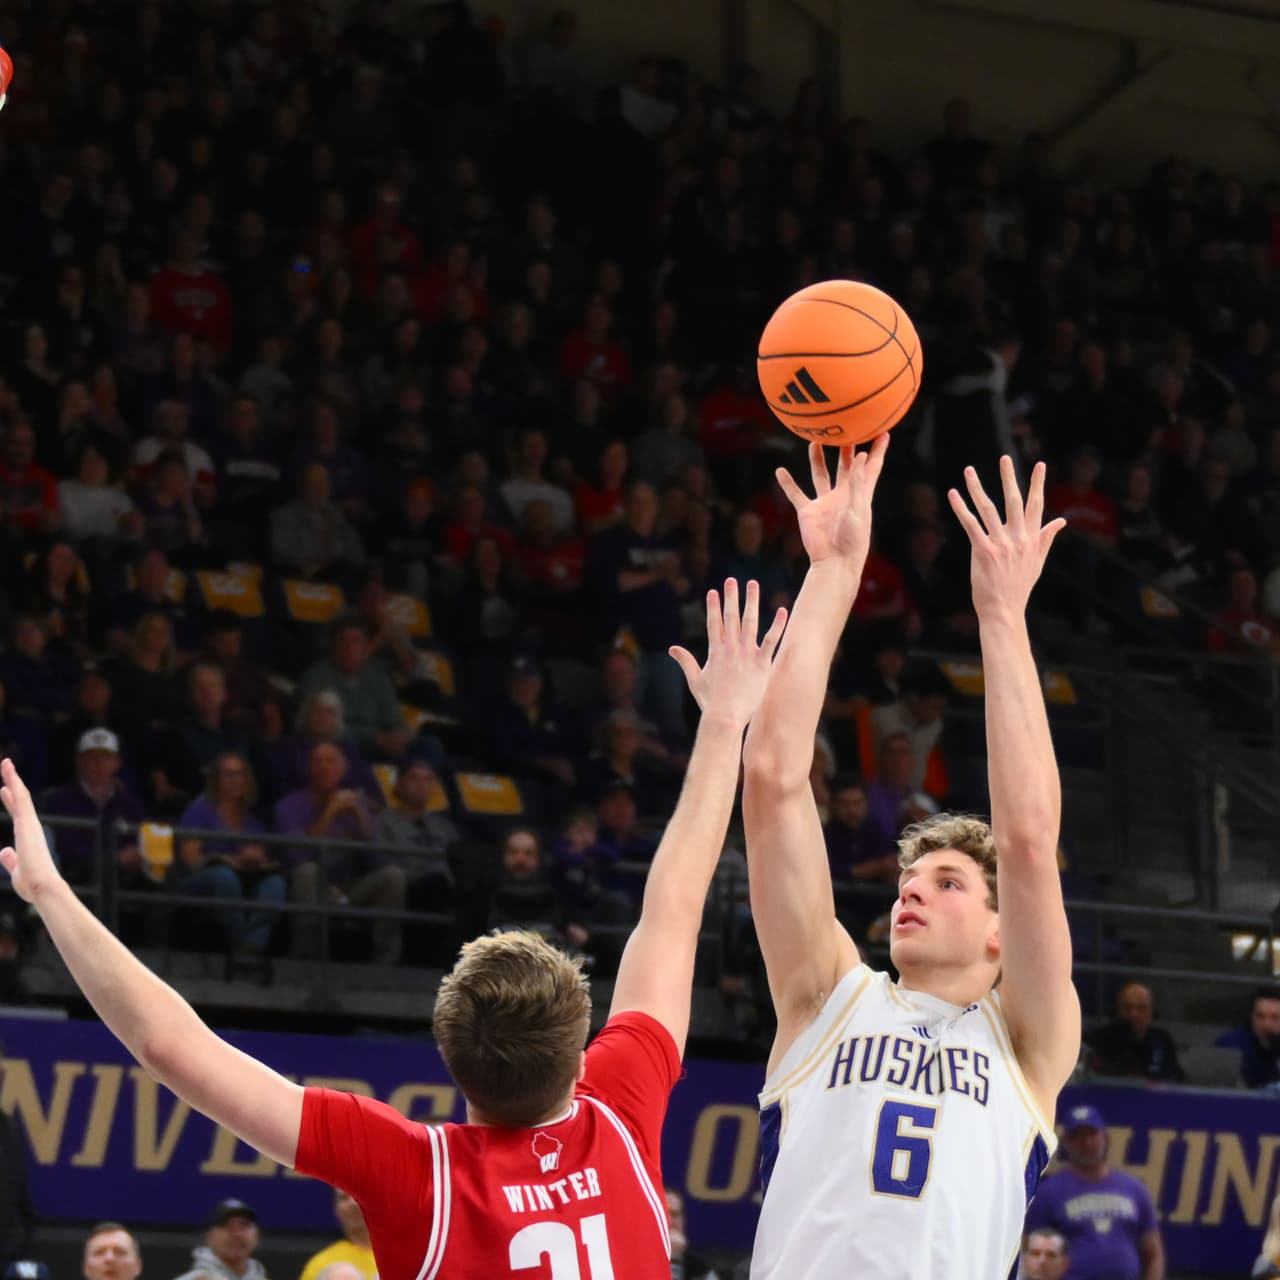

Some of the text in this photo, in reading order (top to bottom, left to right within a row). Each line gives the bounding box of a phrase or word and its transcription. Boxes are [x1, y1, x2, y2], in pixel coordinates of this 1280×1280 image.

[826, 1033, 991, 1108] HUSKIES
[502, 1167, 602, 1214] WINTER
[685, 1103, 764, 1203] O
[868, 1097, 941, 1202] 6
